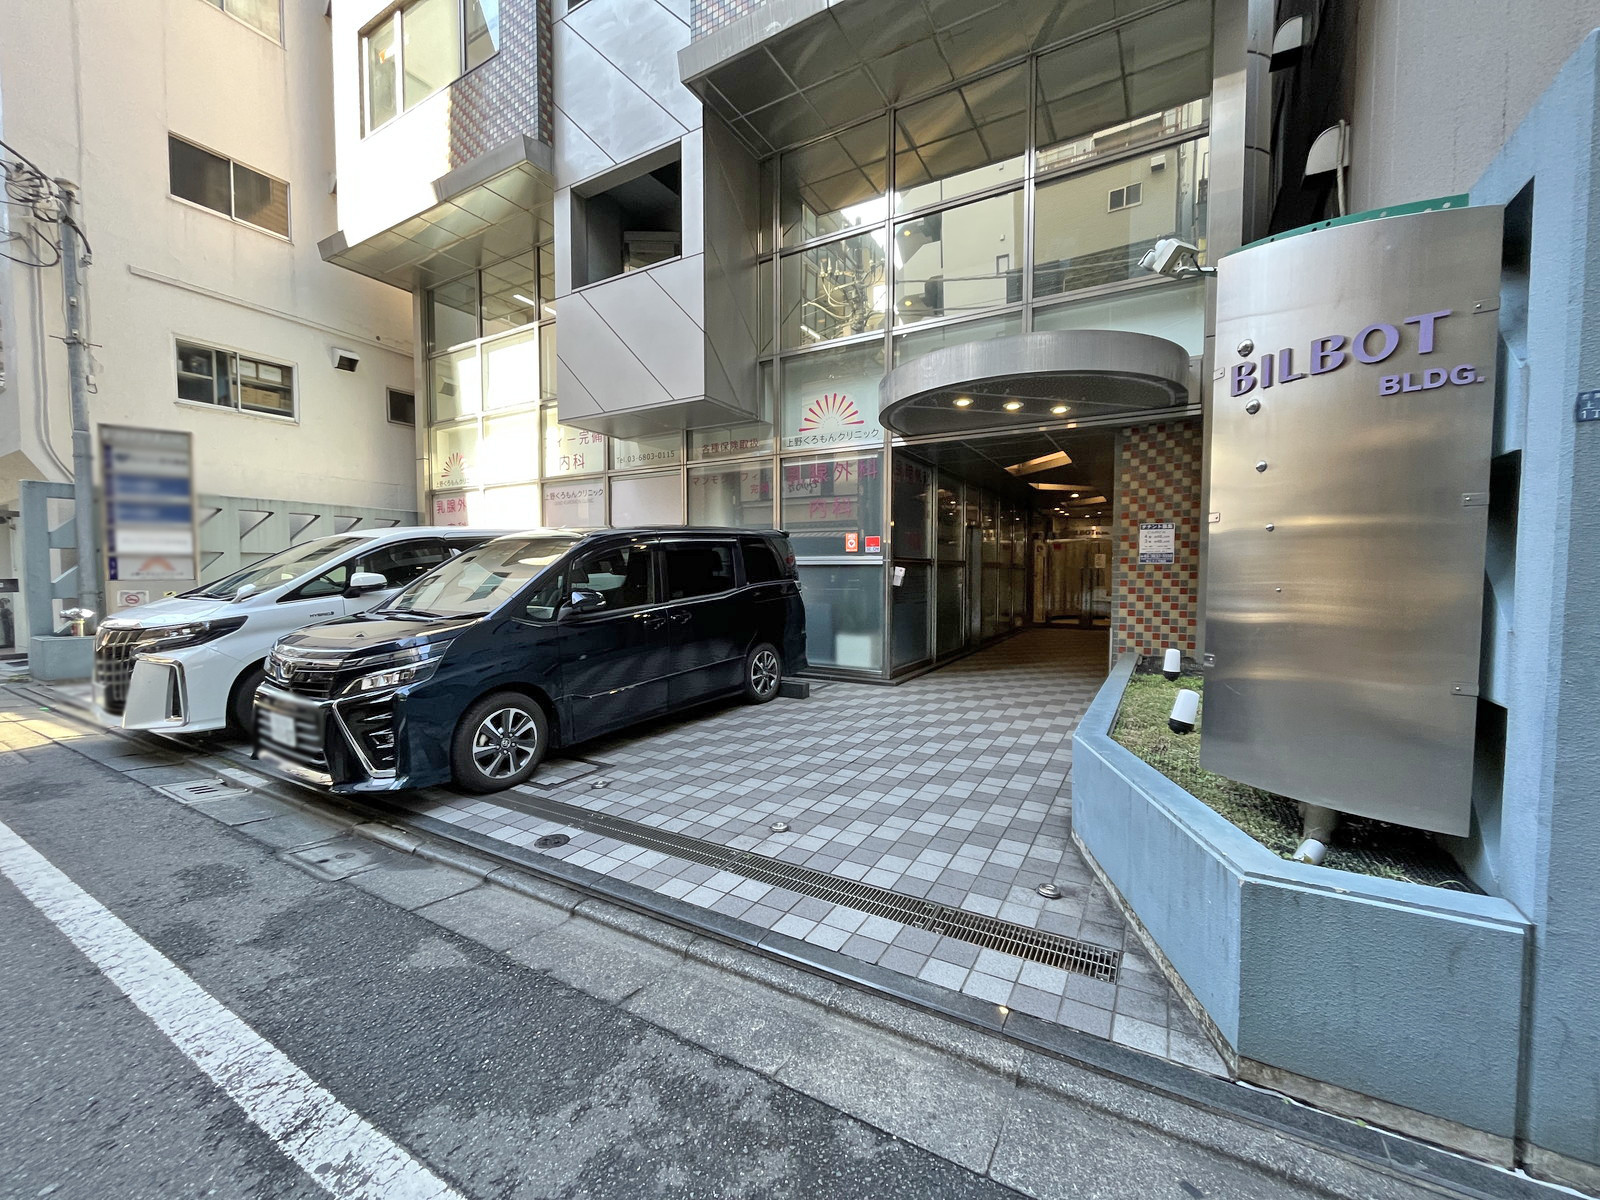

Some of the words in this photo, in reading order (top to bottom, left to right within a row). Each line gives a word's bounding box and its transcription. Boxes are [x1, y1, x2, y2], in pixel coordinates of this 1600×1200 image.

[1230, 309, 1453, 397] BILBOT
[1379, 364, 1485, 396] BLDG.
[786, 428, 879, 447] 上野くろもんクリニック
[559, 452, 585, 470] 内科
[808, 496, 852, 519] 内科
